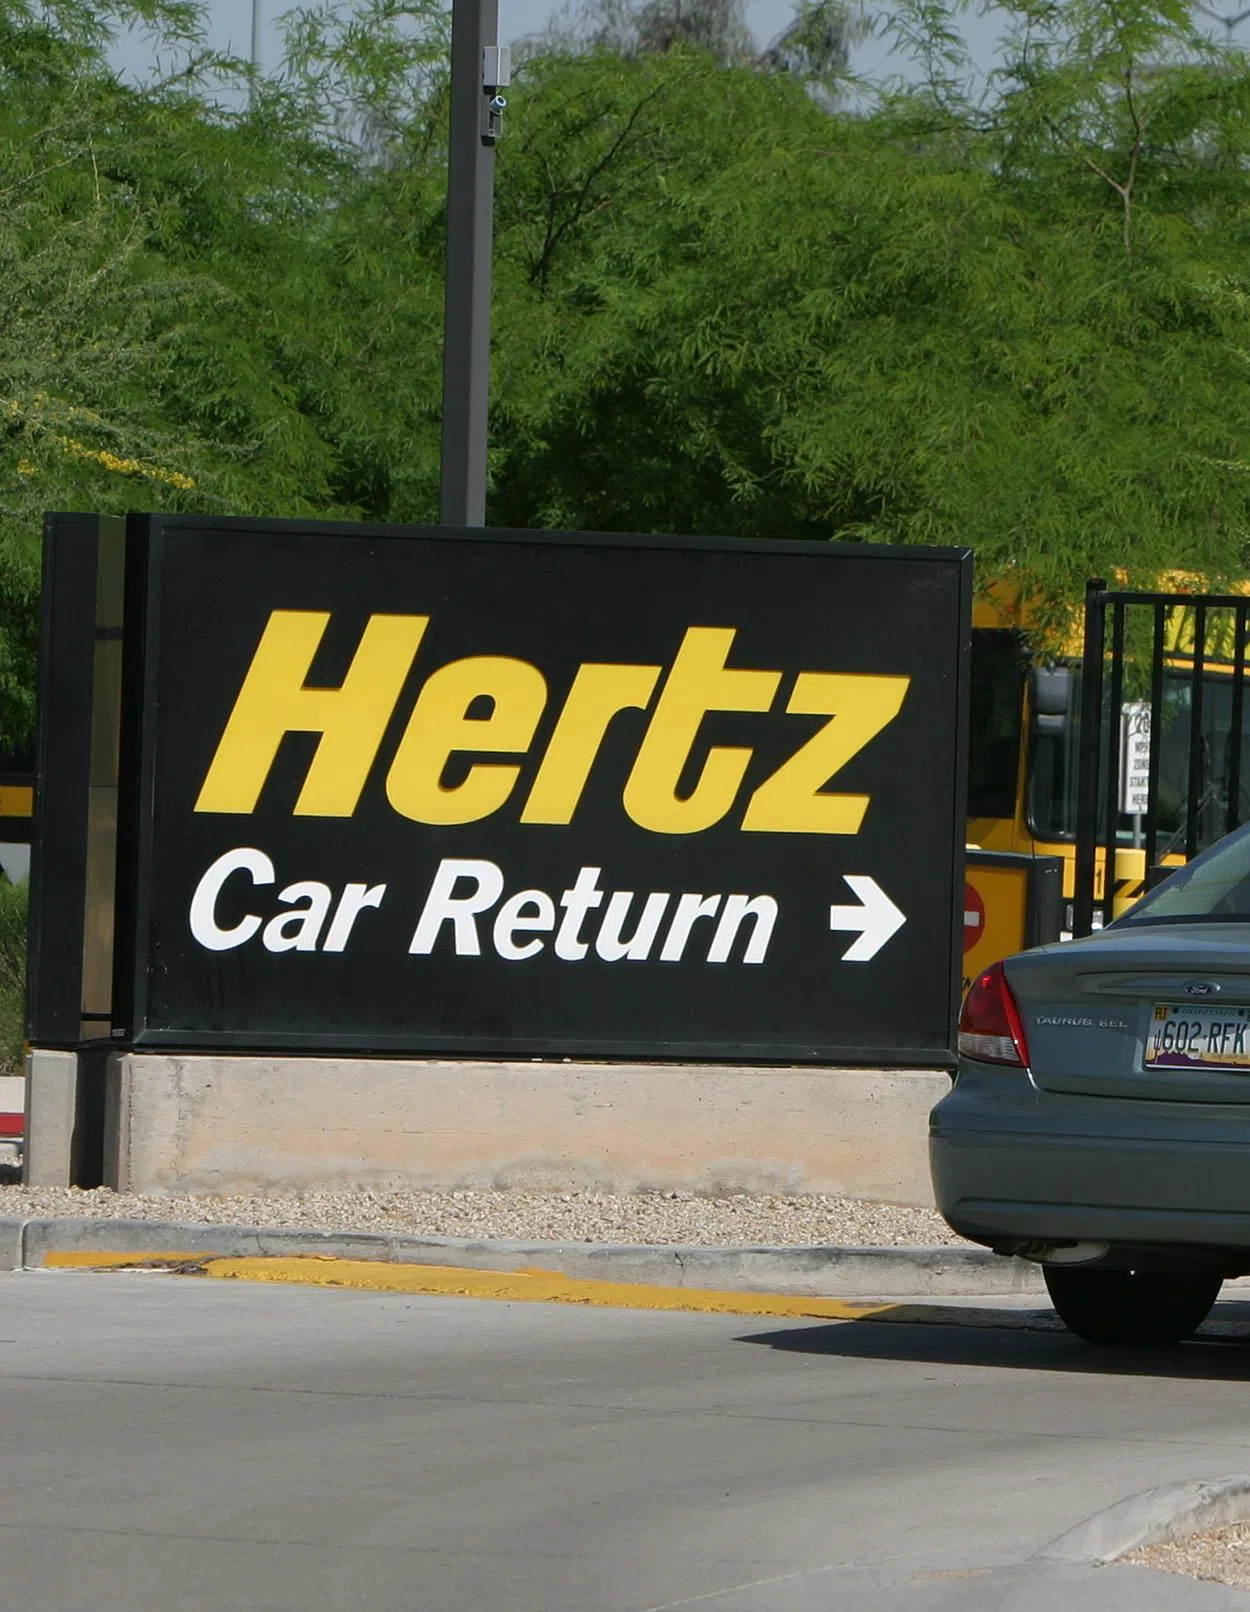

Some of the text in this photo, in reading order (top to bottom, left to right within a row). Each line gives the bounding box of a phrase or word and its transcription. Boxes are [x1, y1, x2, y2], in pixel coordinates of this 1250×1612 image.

[194, 610, 910, 836] Hertz
[190, 848, 779, 965] Car Return
[1035, 1015, 1129, 1028] TAURUS SEL
